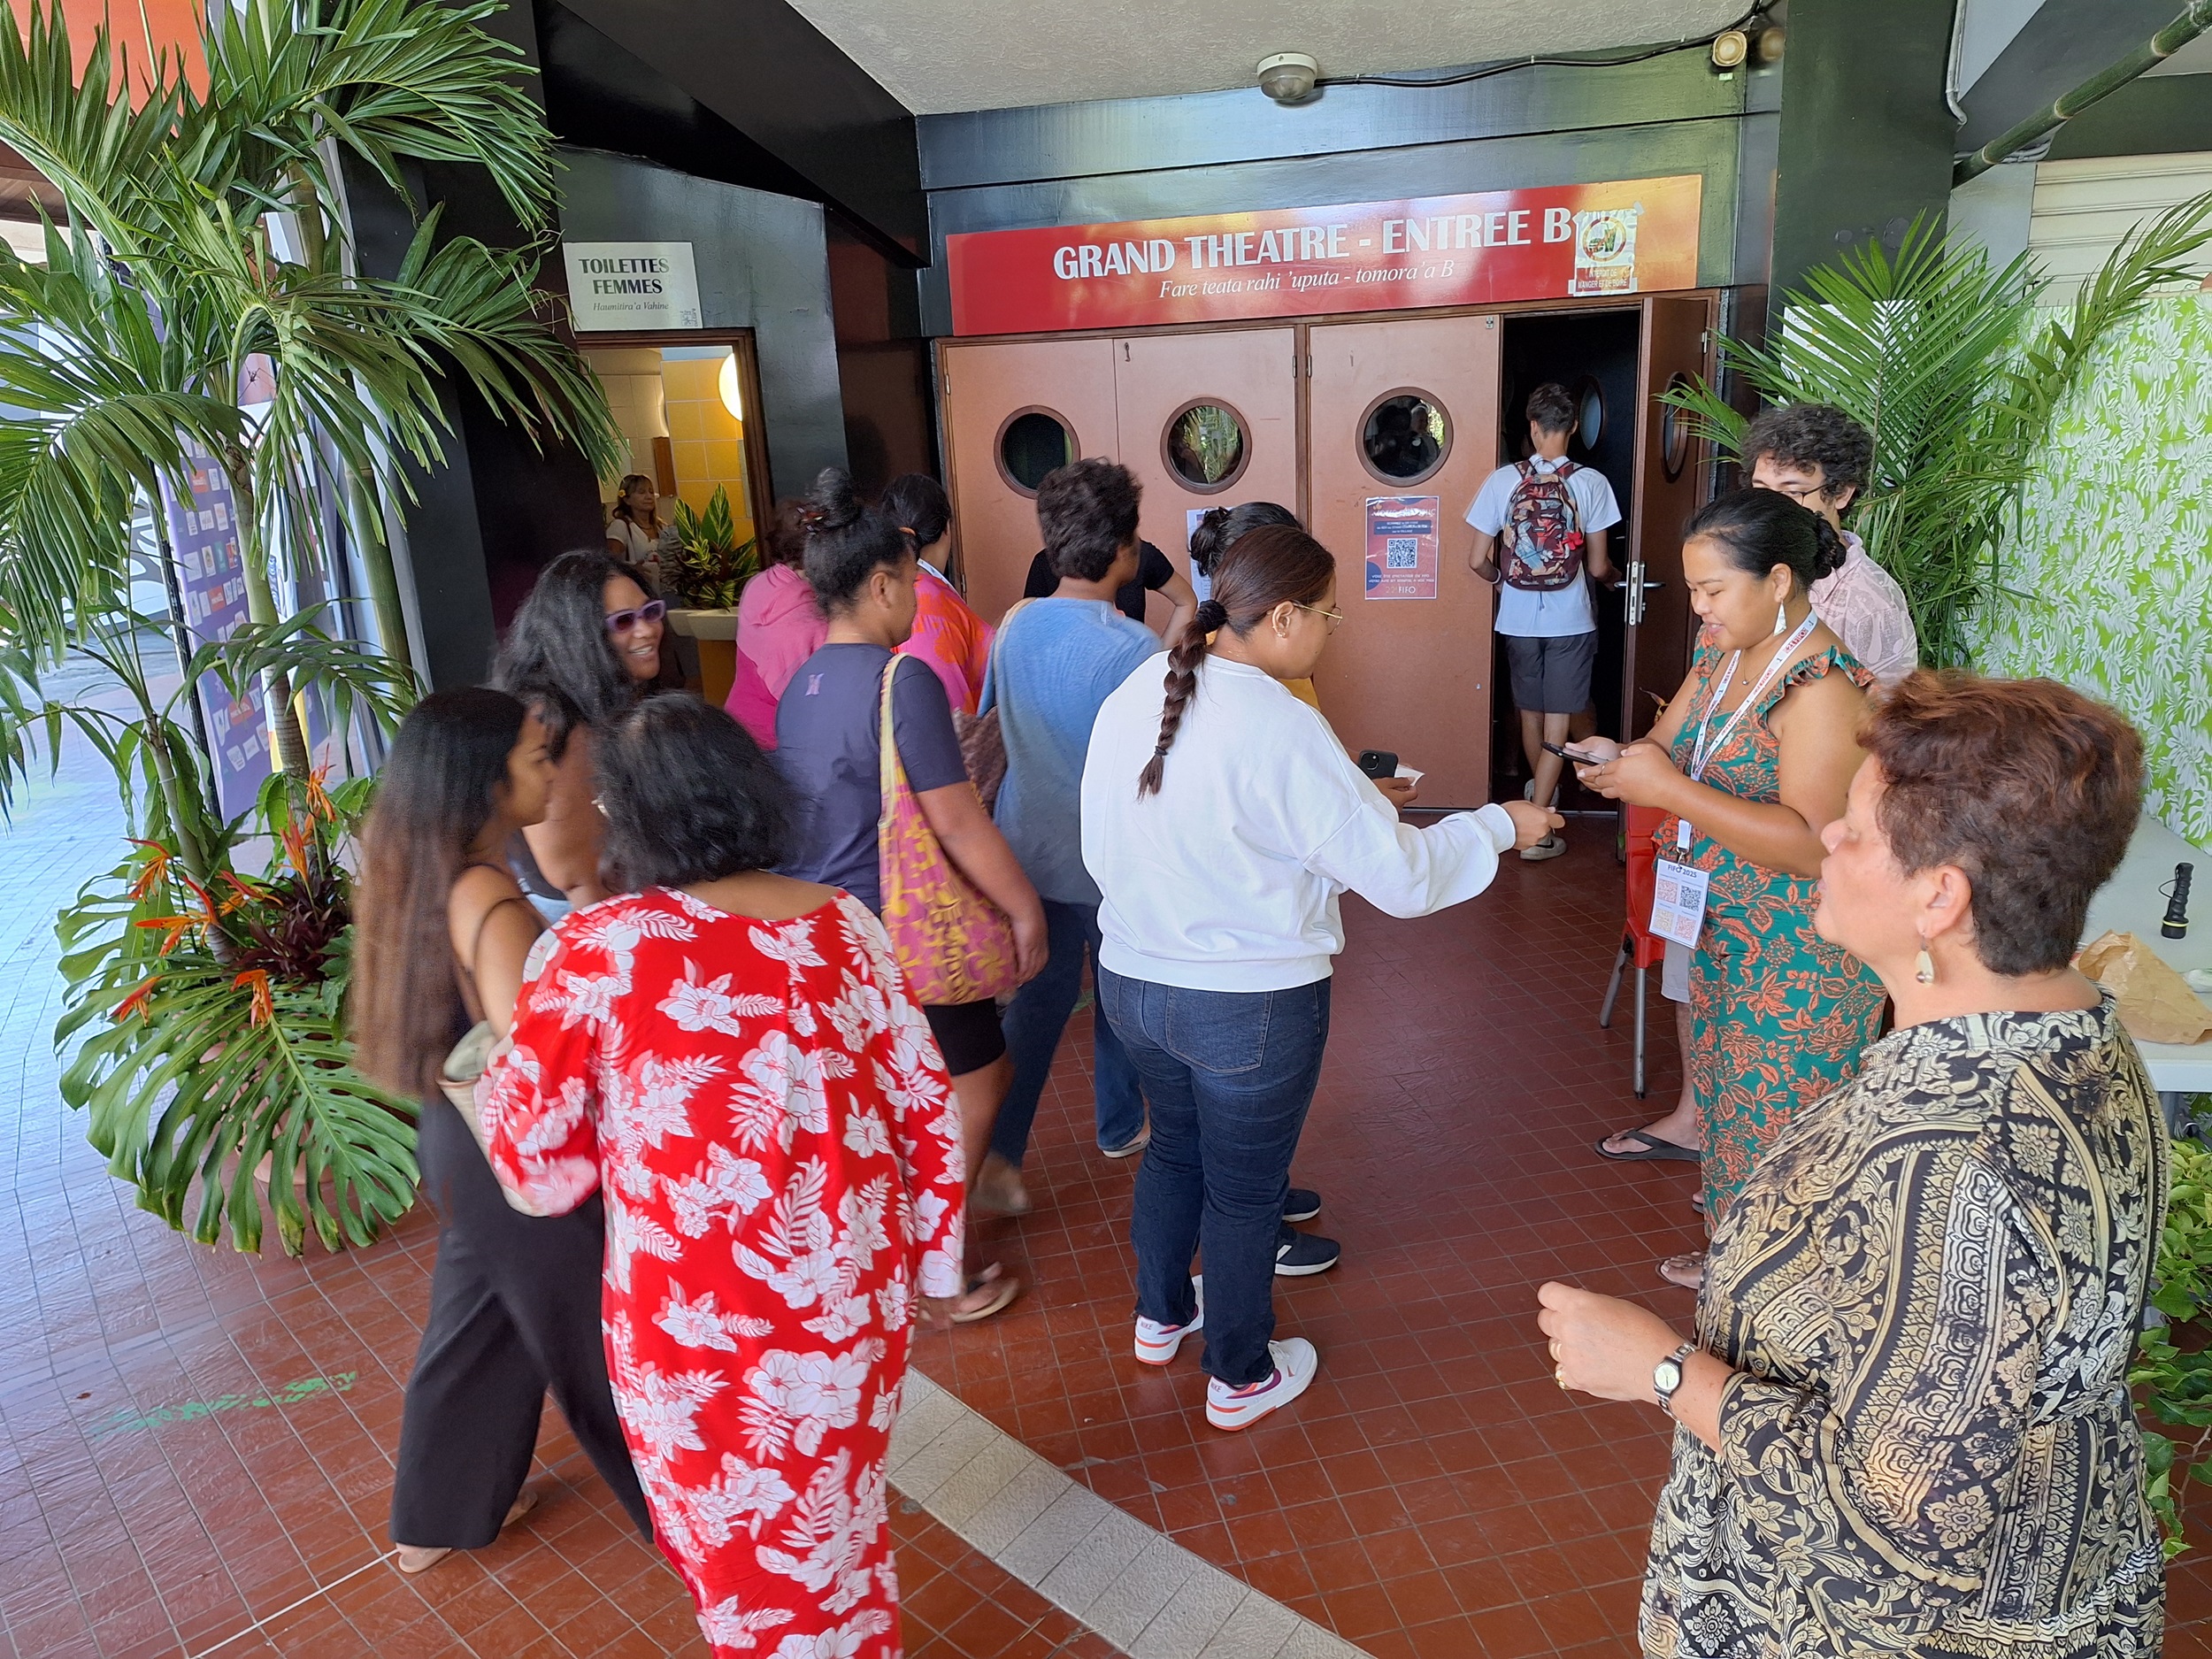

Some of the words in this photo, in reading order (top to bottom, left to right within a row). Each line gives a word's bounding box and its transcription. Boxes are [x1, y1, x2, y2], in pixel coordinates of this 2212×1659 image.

[1054, 239, 1175, 280] GRAND
[1184, 224, 1349, 269] THEATRE
[1382, 210, 1531, 254] ENTREE
[1543, 208, 1571, 243] B
[578, 257, 670, 274] TOILETTES
[1159, 280, 1197, 298] Fare
[1202, 278, 1241, 295] teata
[1247, 273, 1280, 291] rahi
[1440, 260, 1455, 278] B
[593, 279, 663, 295] FEMMES
[643, 301, 669, 311] Vahine
[1667, 864, 1681, 873] FIFO
[1683, 869, 1697, 878] 2025
[1141, 1321, 1154, 1330] NIKE
[1210, 1381, 1222, 1392] NIKE
